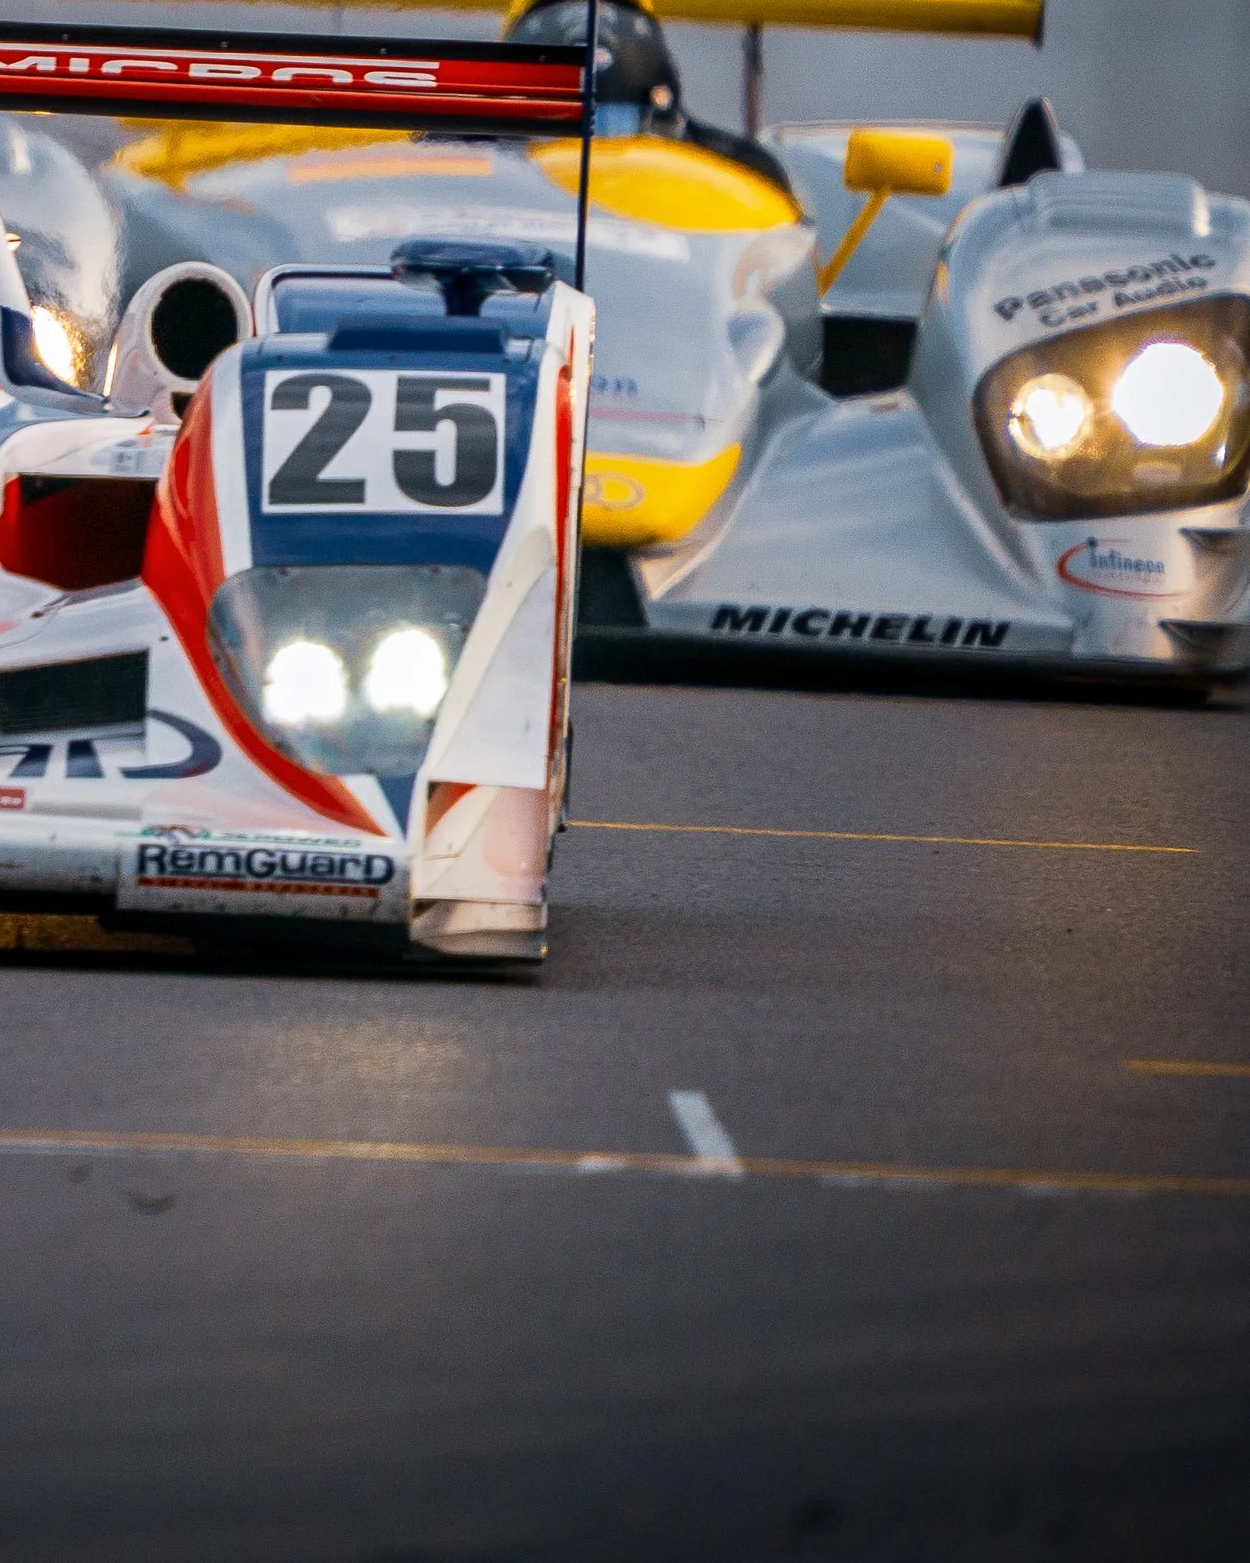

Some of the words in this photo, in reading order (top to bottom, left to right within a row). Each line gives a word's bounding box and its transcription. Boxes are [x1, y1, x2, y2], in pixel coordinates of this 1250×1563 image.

[994, 253, 1216, 322] Panasonic
[1039, 301, 1098, 328] Car
[1113, 276, 1208, 308] Audio
[268, 372, 498, 507] 25
[710, 604, 1011, 646] MICHELIN
